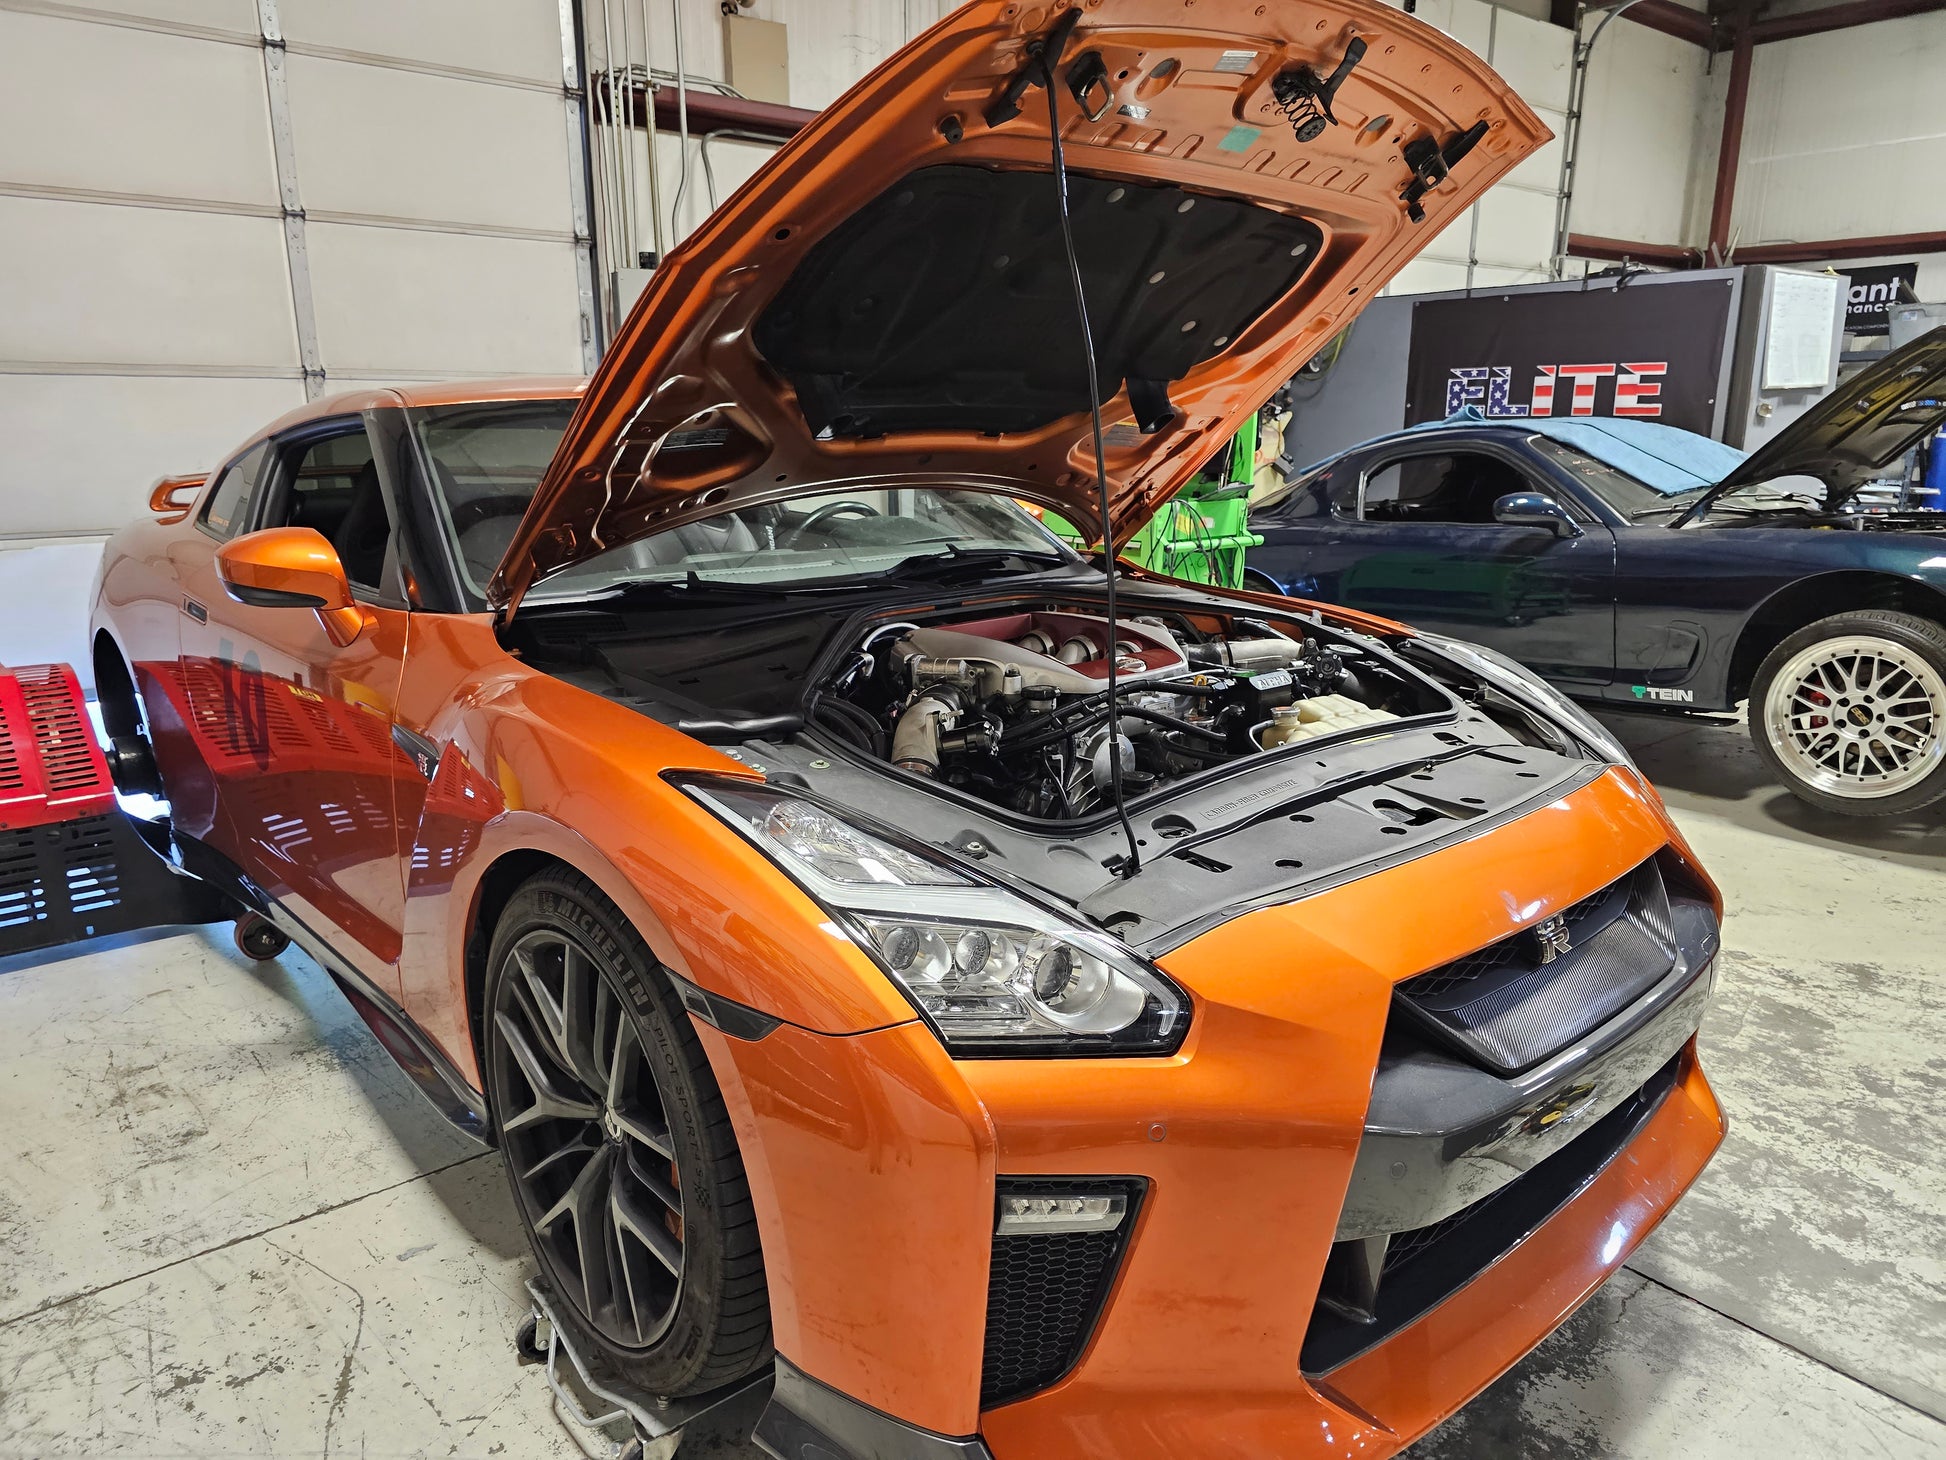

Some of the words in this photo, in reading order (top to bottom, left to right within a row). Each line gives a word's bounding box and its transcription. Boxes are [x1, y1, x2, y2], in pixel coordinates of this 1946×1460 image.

[1847, 277, 1900, 303] ant
[1445, 362, 1667, 417] ELITE
[1646, 687, 1693, 702] TEIN
[557, 897, 650, 1007] MICHELIN
[653, 1027, 679, 1077] PILOT
[675, 1085, 699, 1152] SPORT
